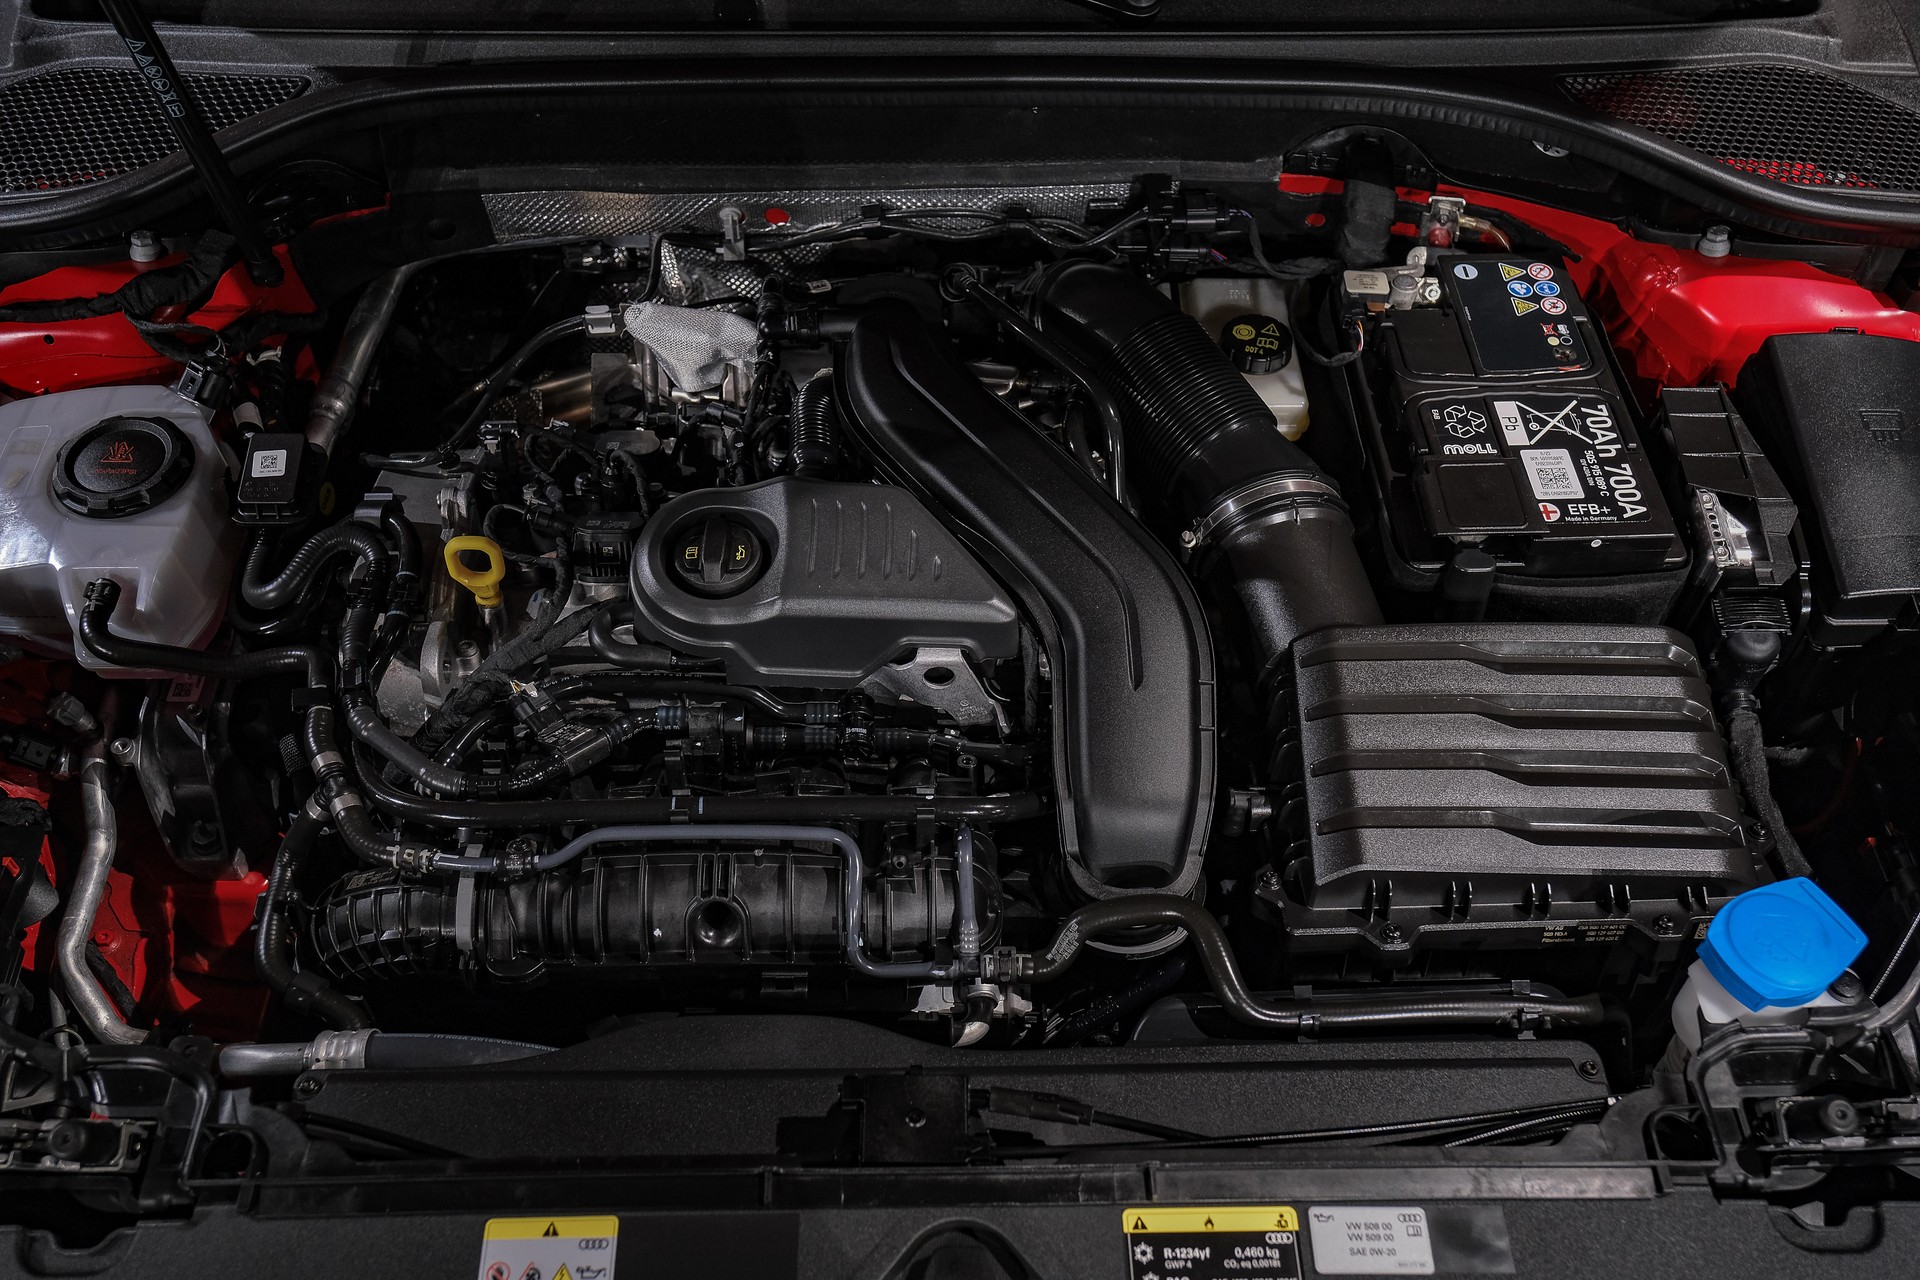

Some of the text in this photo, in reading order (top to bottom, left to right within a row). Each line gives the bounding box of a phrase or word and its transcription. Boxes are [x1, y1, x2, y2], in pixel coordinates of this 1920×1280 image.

[1245, 345, 1258, 354] DOT
[1501, 416, 1520, 431] Pb
[1580, 404, 1648, 519] 70Ah 700A
[1591, 464, 1601, 476] 915
[1567, 504, 1611, 515] EFB+
[1589, 515, 1617, 523] Germany
[1345, 1222, 1361, 1230] VW
[1381, 1222, 1393, 1230] 00
[1347, 1233, 1363, 1241] VW
[1383, 1233, 1395, 1241] 00
[1163, 1246, 1280, 1261] R-1234yf 0,460 kg
[1349, 1247, 1397, 1256] SAE 0W-20
[1164, 1260, 1185, 1269] GWP
[1186, 1260, 1192, 1269] 4
[1240, 1261, 1252, 1270] eq
